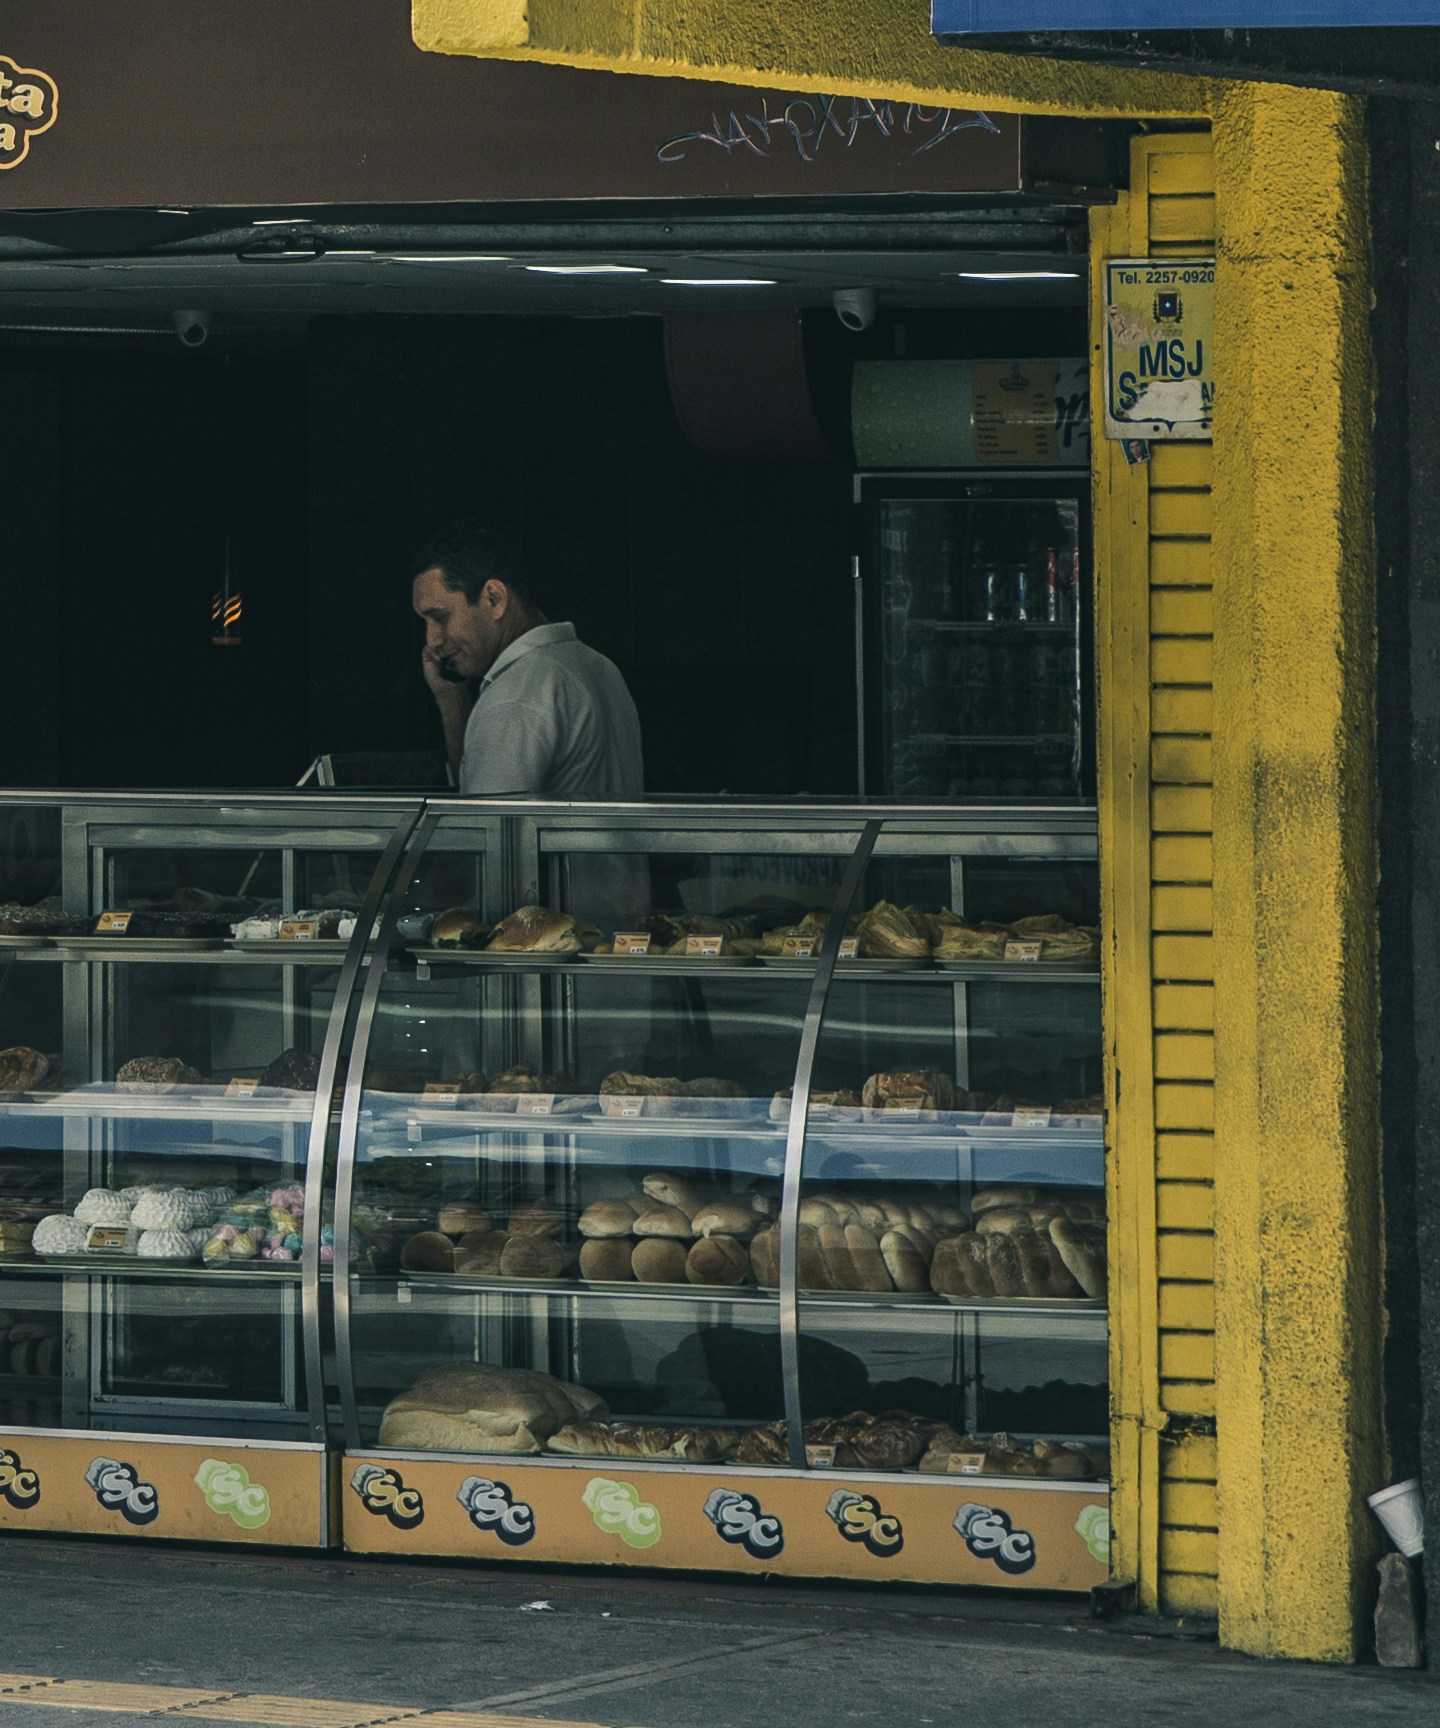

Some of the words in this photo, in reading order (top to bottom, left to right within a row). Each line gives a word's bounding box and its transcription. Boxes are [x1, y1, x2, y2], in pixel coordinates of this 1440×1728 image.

[1118, 271, 1141, 284] Tel.
[1146, 271, 1215, 284] 2257-0920
[1139, 338, 1203, 378] MSJ
